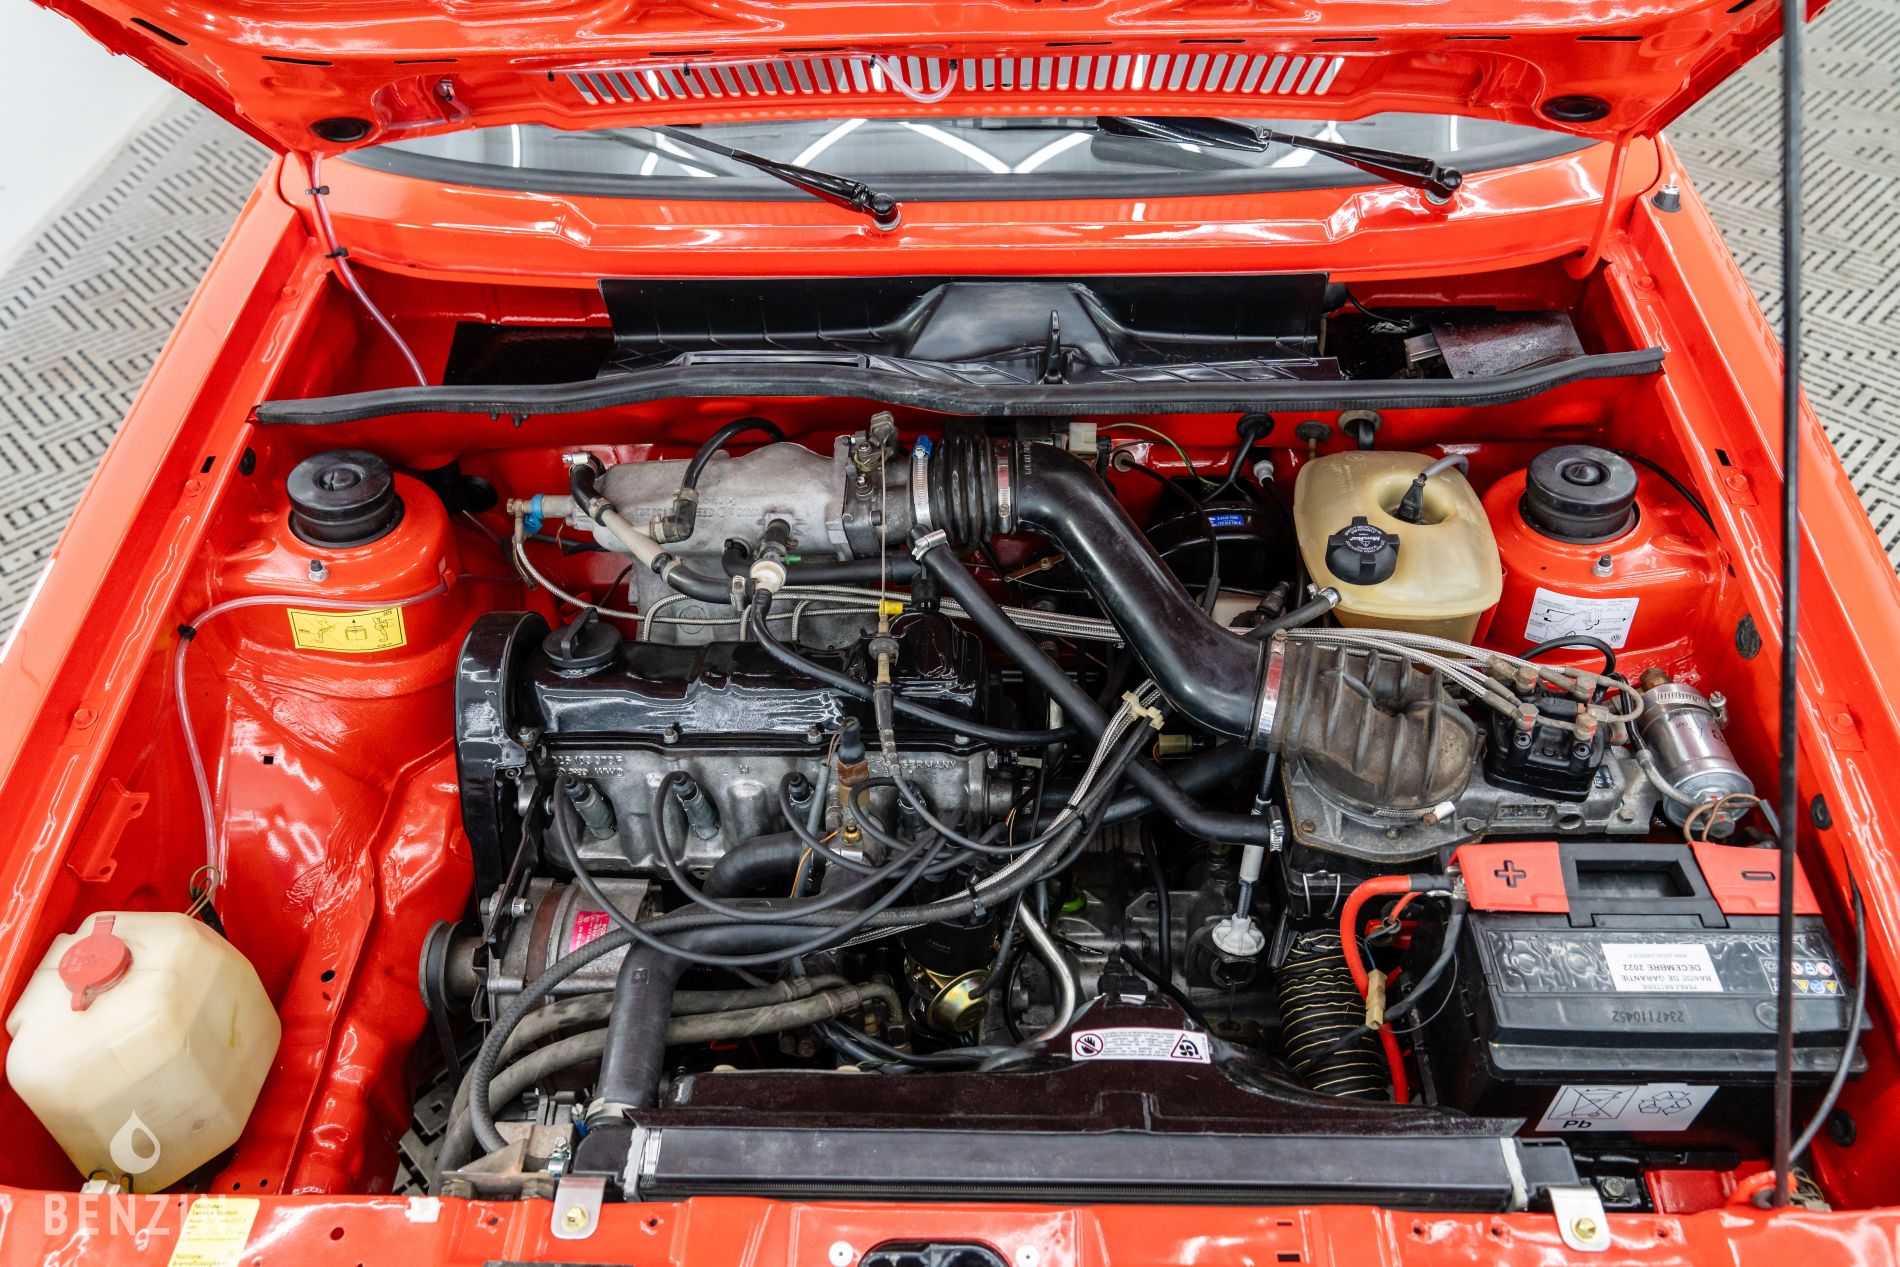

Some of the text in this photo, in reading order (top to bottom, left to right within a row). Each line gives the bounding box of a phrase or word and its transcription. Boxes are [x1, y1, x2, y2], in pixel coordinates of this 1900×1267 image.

[1646, 964, 1701, 972] DECEMBRE
[1620, 974, 1665, 982] GARANTIE
[1612, 1010, 1684, 1023] 2347110452
[1562, 1120, 1592, 1129] Pb
